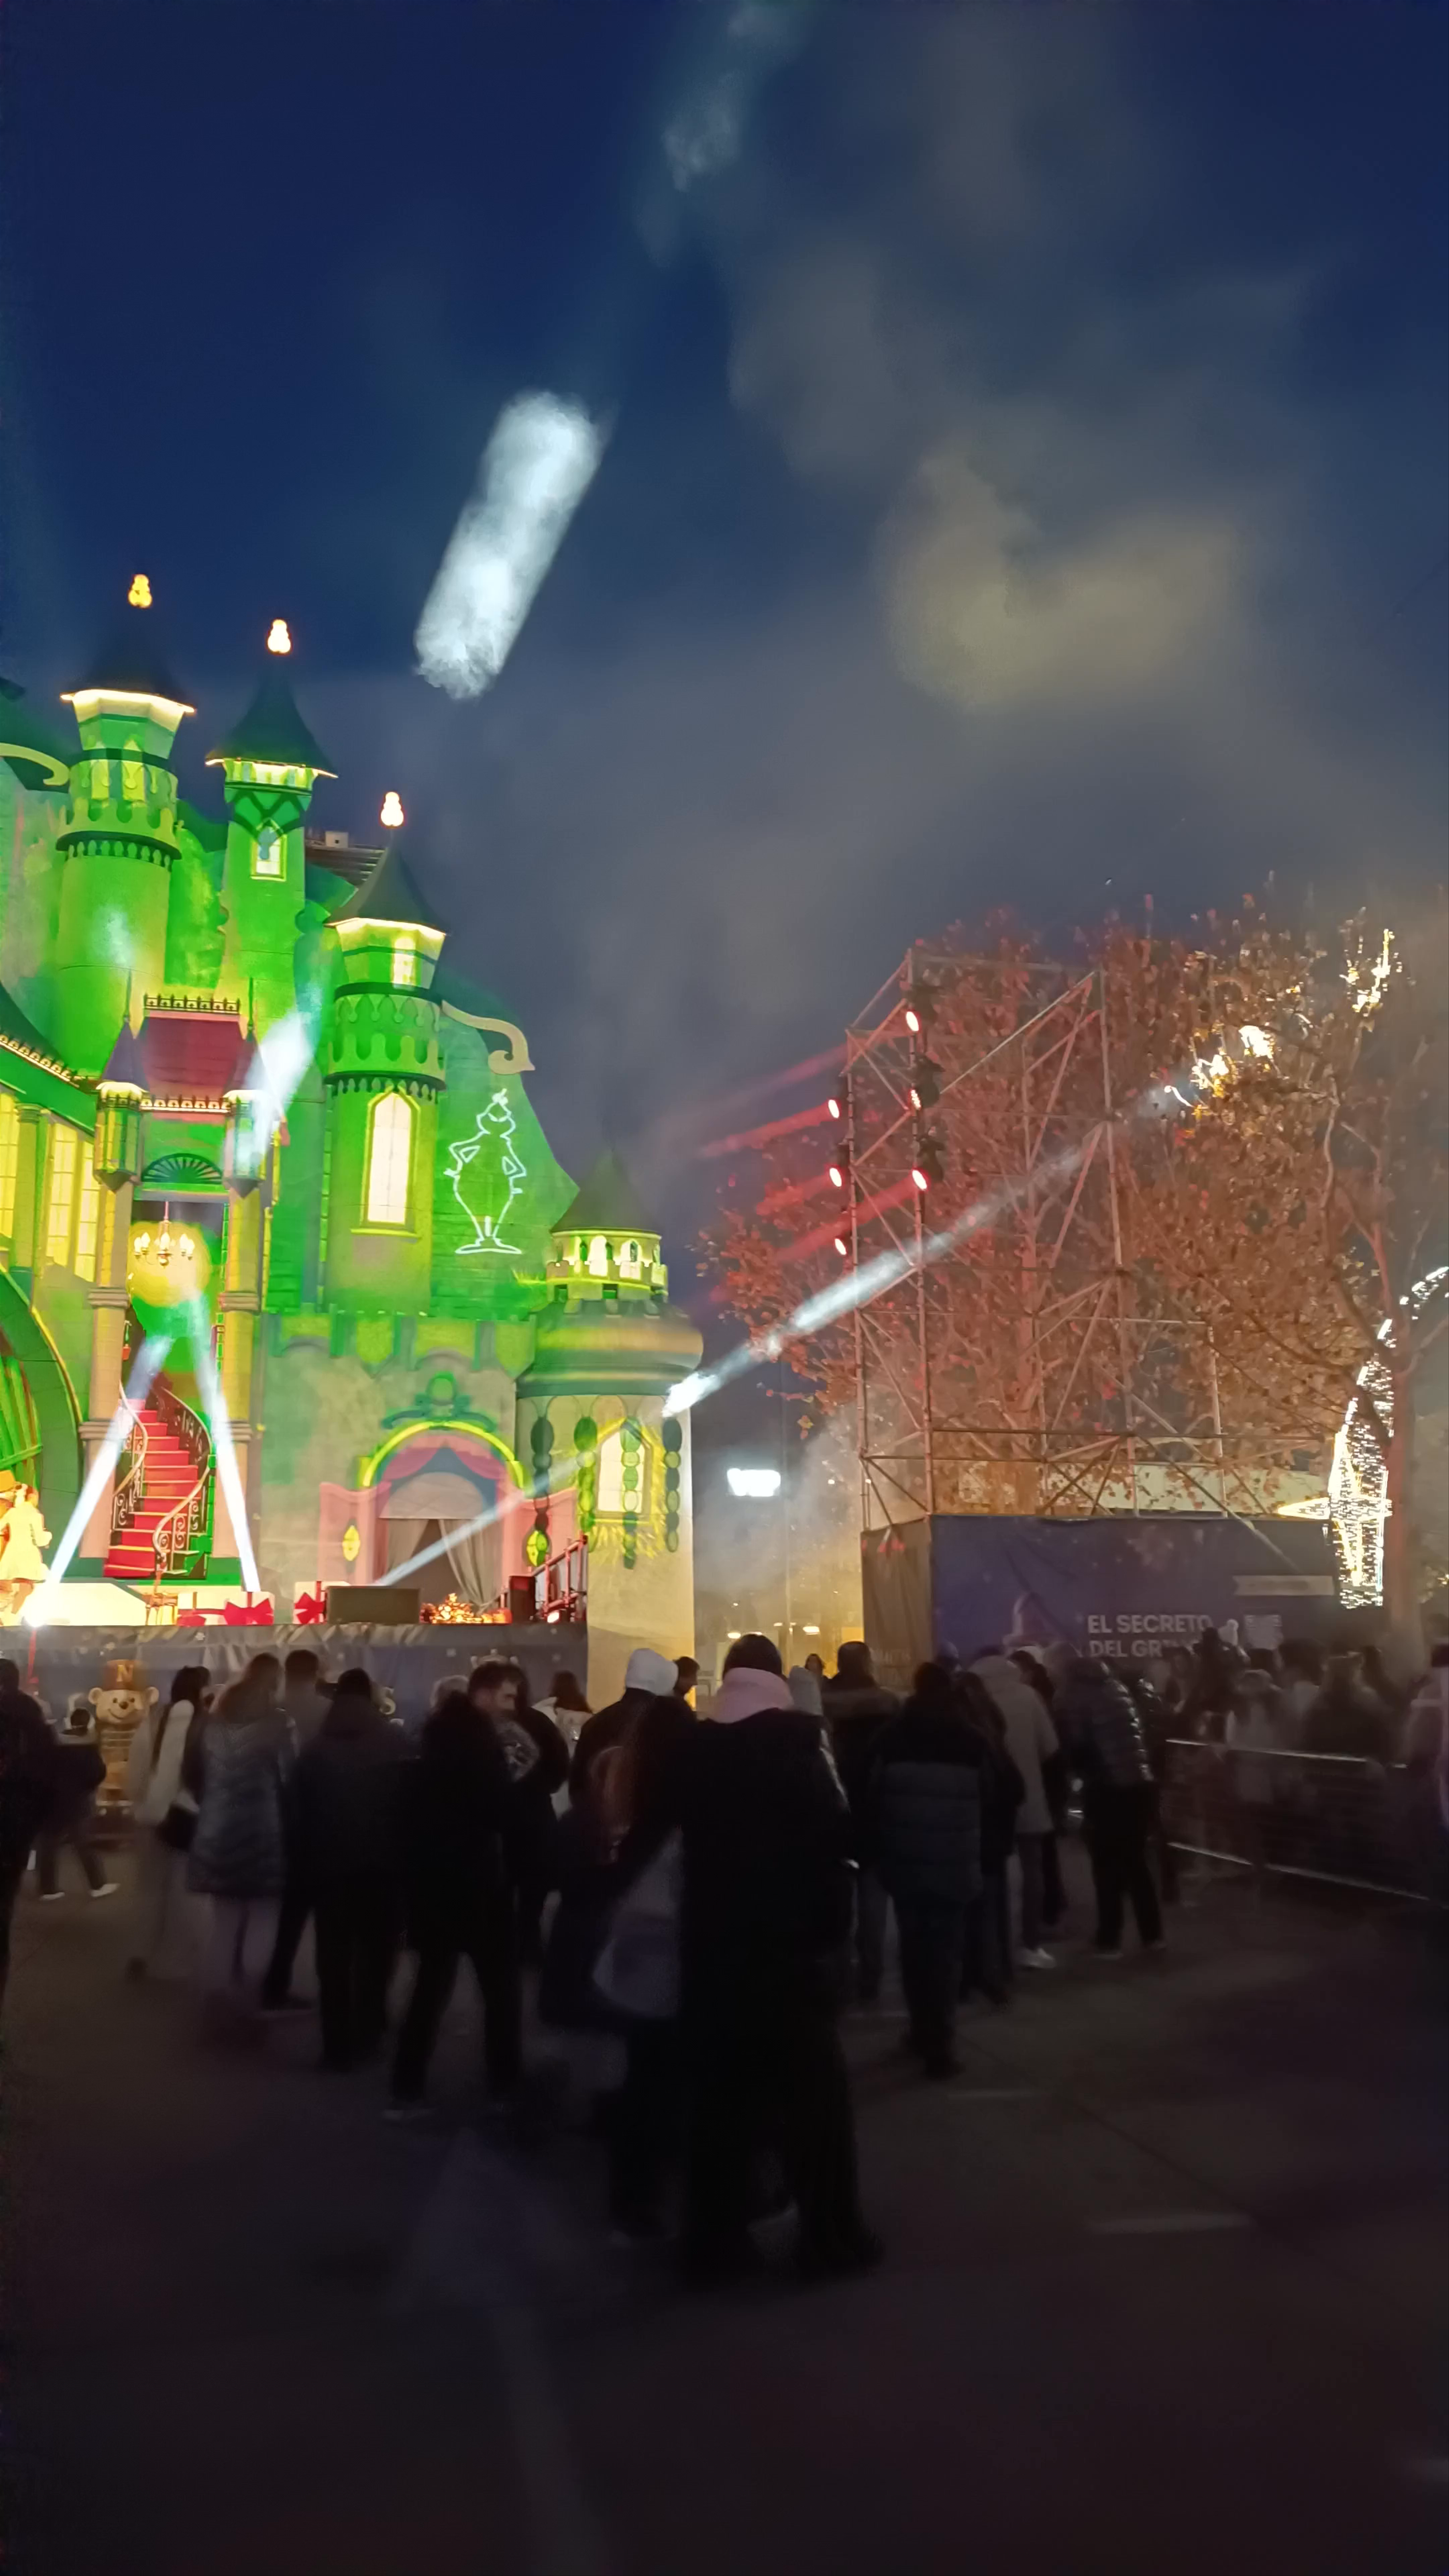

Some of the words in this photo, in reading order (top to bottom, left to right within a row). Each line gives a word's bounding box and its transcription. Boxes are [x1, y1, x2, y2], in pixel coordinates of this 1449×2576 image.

[1088, 1615, 1112, 1633] EL
[1116, 1615, 1213, 1633] SECRETO
[1089, 1640, 1128, 1657] DEL
[117, 1664, 134, 1682] N
